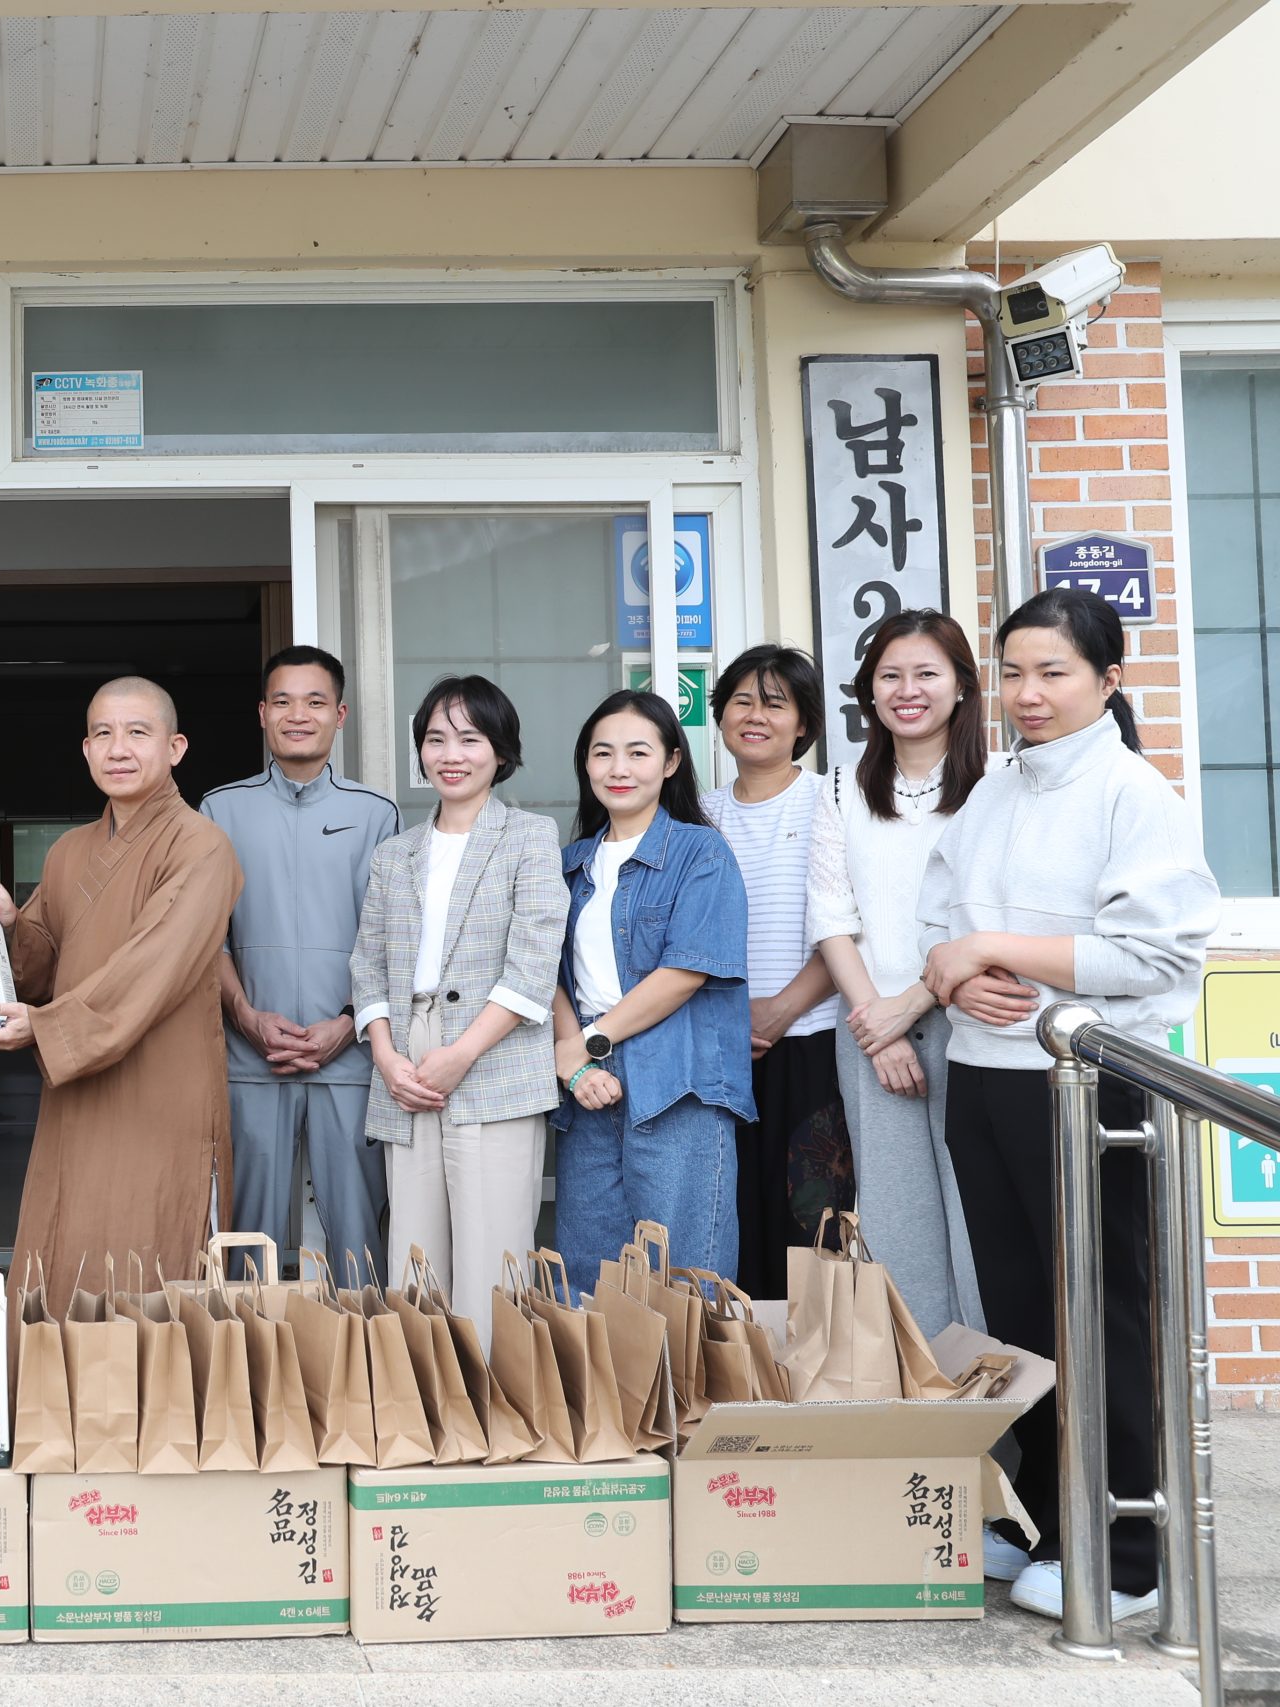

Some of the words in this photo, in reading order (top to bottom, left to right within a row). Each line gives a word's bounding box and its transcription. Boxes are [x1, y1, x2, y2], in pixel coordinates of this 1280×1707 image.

[54, 377, 82, 389] CCTV
[1075, 546, 1115, 560] 종동길
[1069, 559, 1123, 569] Jongdong-gil
[572, 1484, 590, 1496] 명품
[592, 1483, 646, 1495] 소문난삼부자
[707, 1471, 740, 1493] 소문난
[69, 1489, 102, 1511] 소문난
[376, 1492, 401, 1503] 6세트
[410, 1492, 427, 1501] 4캔
[543, 1486, 571, 1498] 정성김
[723, 1486, 776, 1508] 삼부자
[902, 1472, 932, 1527] 名品
[85, 1504, 138, 1526] 삼부자
[265, 1488, 296, 1544] 名品
[932, 1485, 954, 1568] 정성김
[296, 1500, 317, 1584] 정성김
[389, 1525, 412, 1611] 정성김
[412, 1566, 443, 1622] 名品
[567, 1581, 621, 1603] 삼부자
[696, 1592, 751, 1603] 소문난삼부자
[753, 1592, 771, 1602] 명품
[773, 1591, 800, 1603] 정성김
[941, 1590, 966, 1600] 6세트
[280, 1607, 296, 1616] 4캔
[306, 1606, 330, 1616] 6세트
[604, 1596, 637, 1617] 소문난
[56, 1611, 112, 1623] 소문난삼부자
[114, 1611, 132, 1623] 명품
[133, 1610, 162, 1622] 정성김
